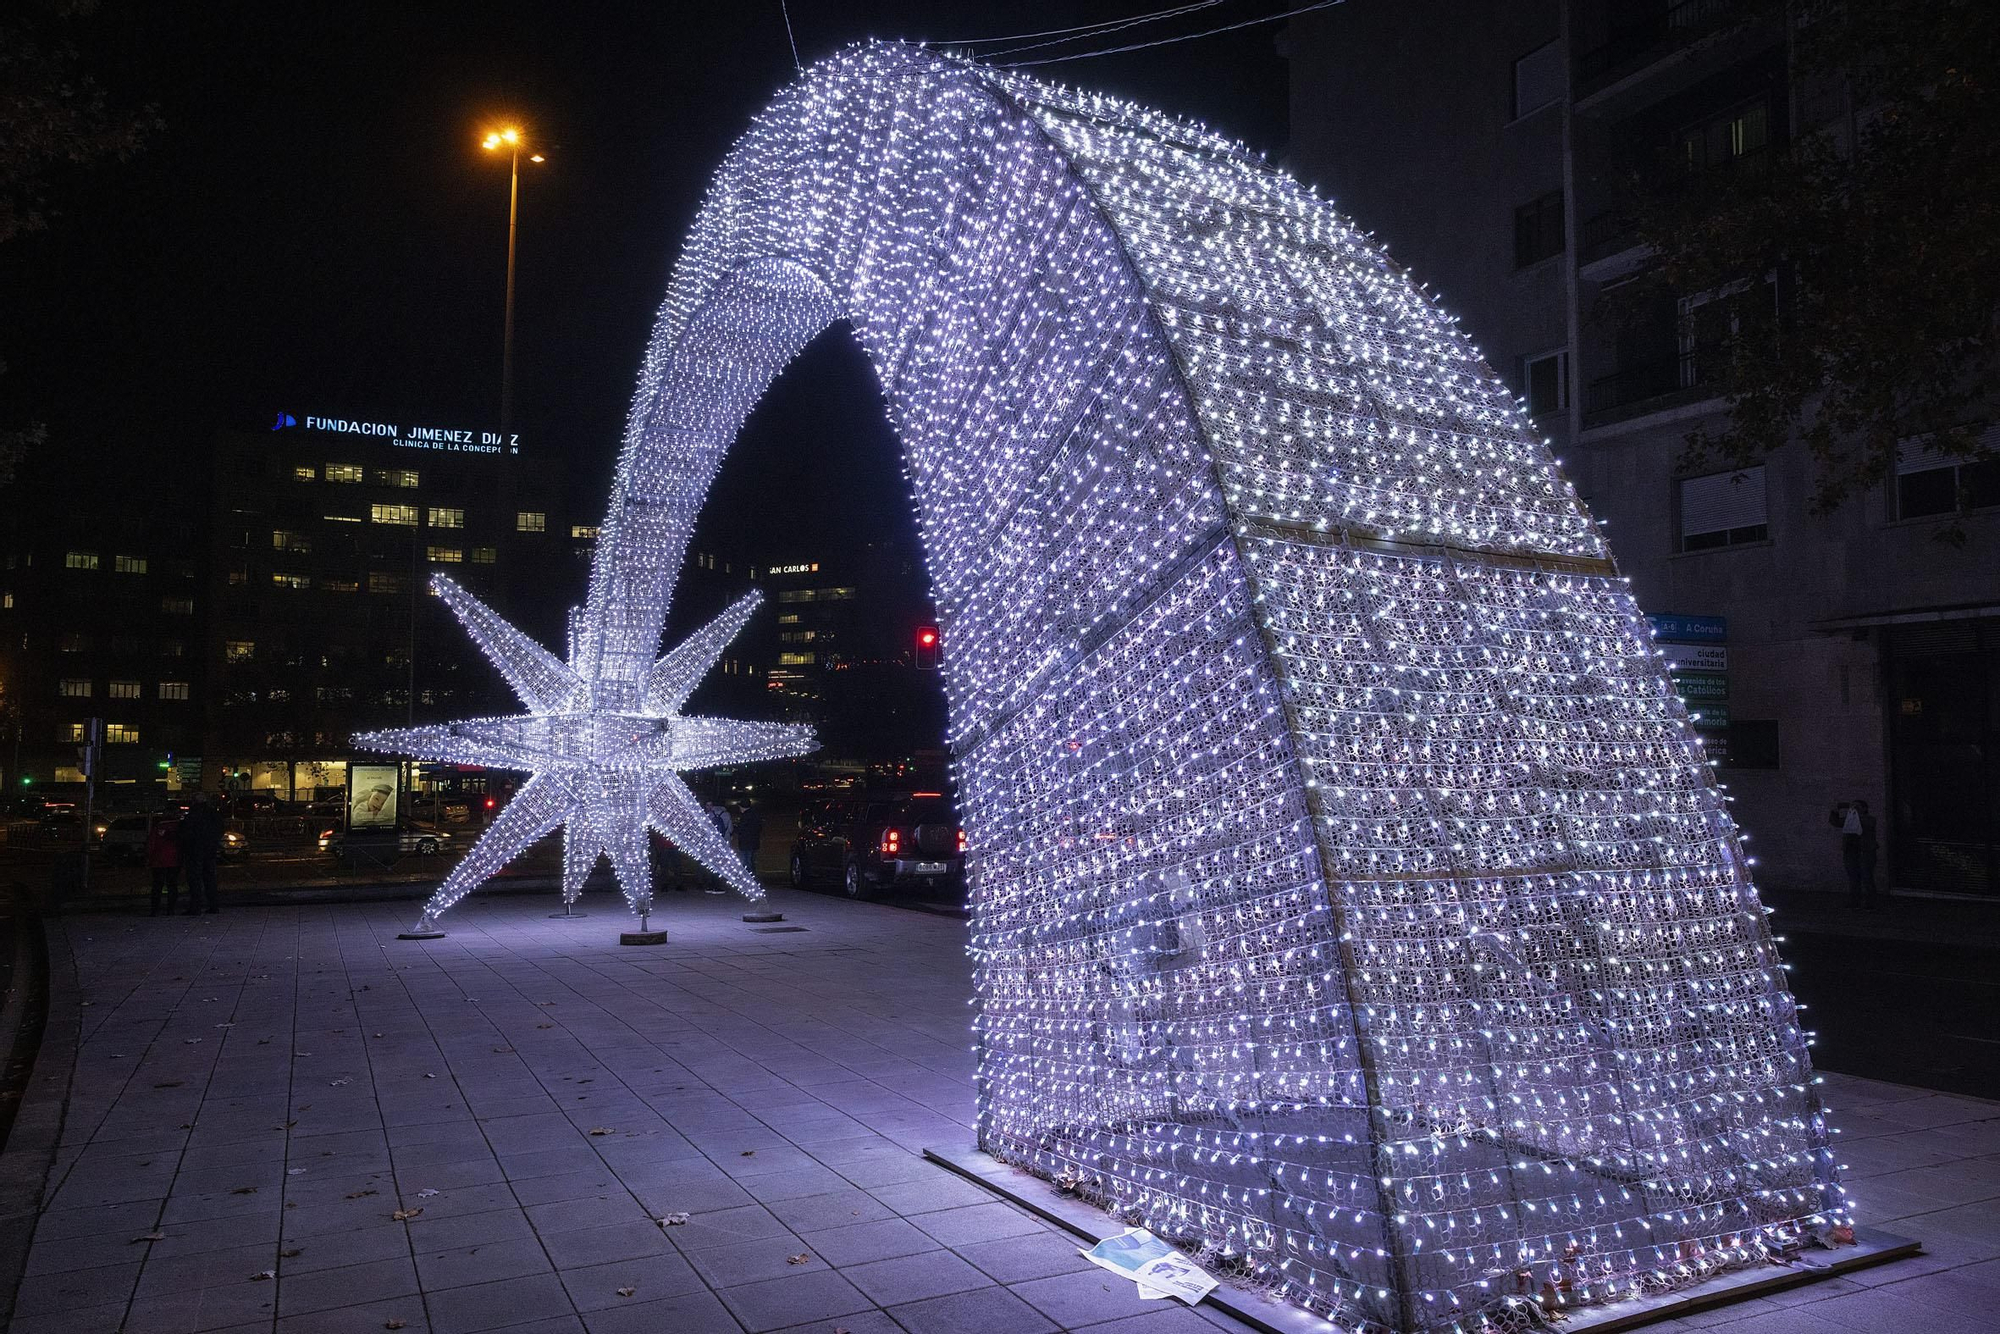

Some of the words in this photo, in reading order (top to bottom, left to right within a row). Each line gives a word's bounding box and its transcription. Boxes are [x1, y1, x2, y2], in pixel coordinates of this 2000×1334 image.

[306, 416, 397, 437] FUNDACION
[407, 427, 472, 443] JIMENEZ
[393, 439, 430, 449] CLINICA
[432, 441, 444, 450] DE
[448, 442, 460, 451] LA
[462, 444, 518, 455] CONCEPCN
[783, 564, 809, 573] CARLOS
[1697, 649, 1725, 659] ciudad
[1675, 658, 1725, 668] universitaria
